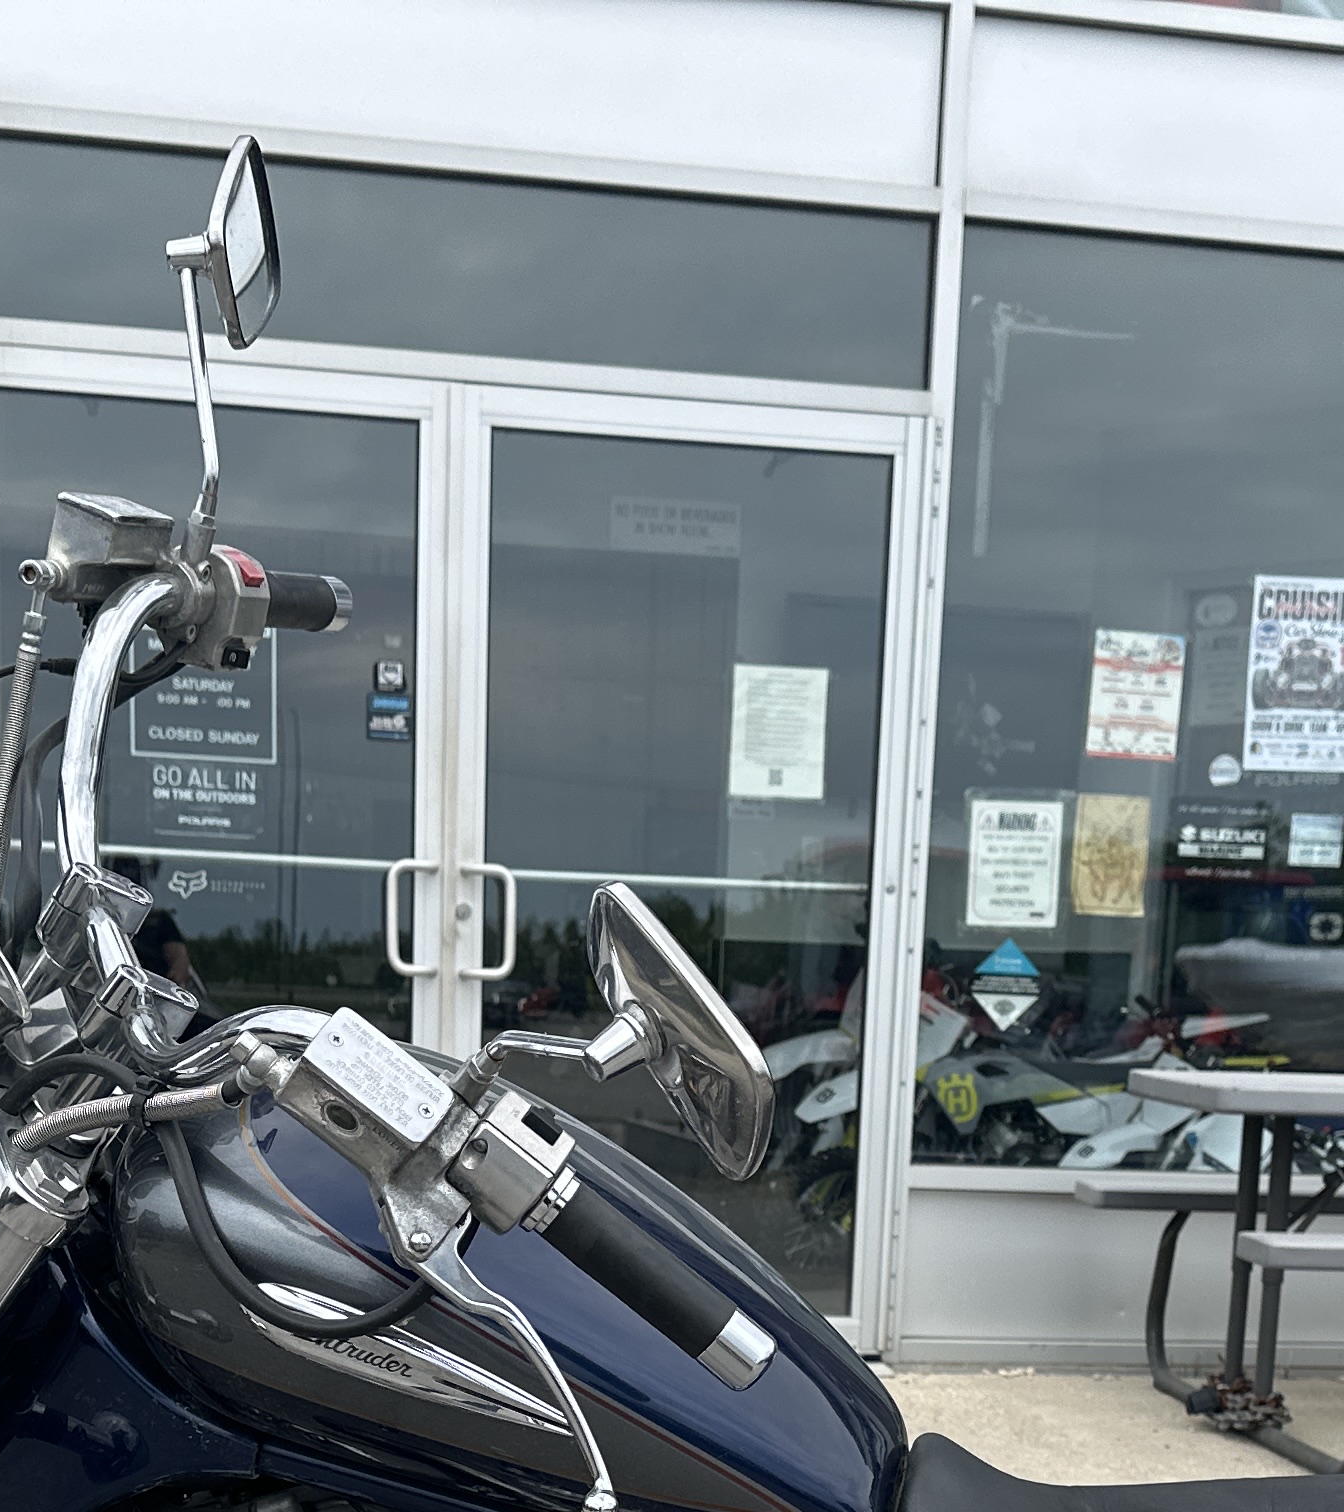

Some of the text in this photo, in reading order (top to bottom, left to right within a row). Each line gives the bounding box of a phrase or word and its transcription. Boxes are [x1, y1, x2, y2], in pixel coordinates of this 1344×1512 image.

[171, 676, 235, 694] SATURDAY
[148, 726, 260, 746] CLOSED SUNDAY
[152, 764, 256, 792] GO ALL IN
[152, 787, 256, 806] ON THE OUTDOORS
[304, 1334, 412, 1378] ntruder
